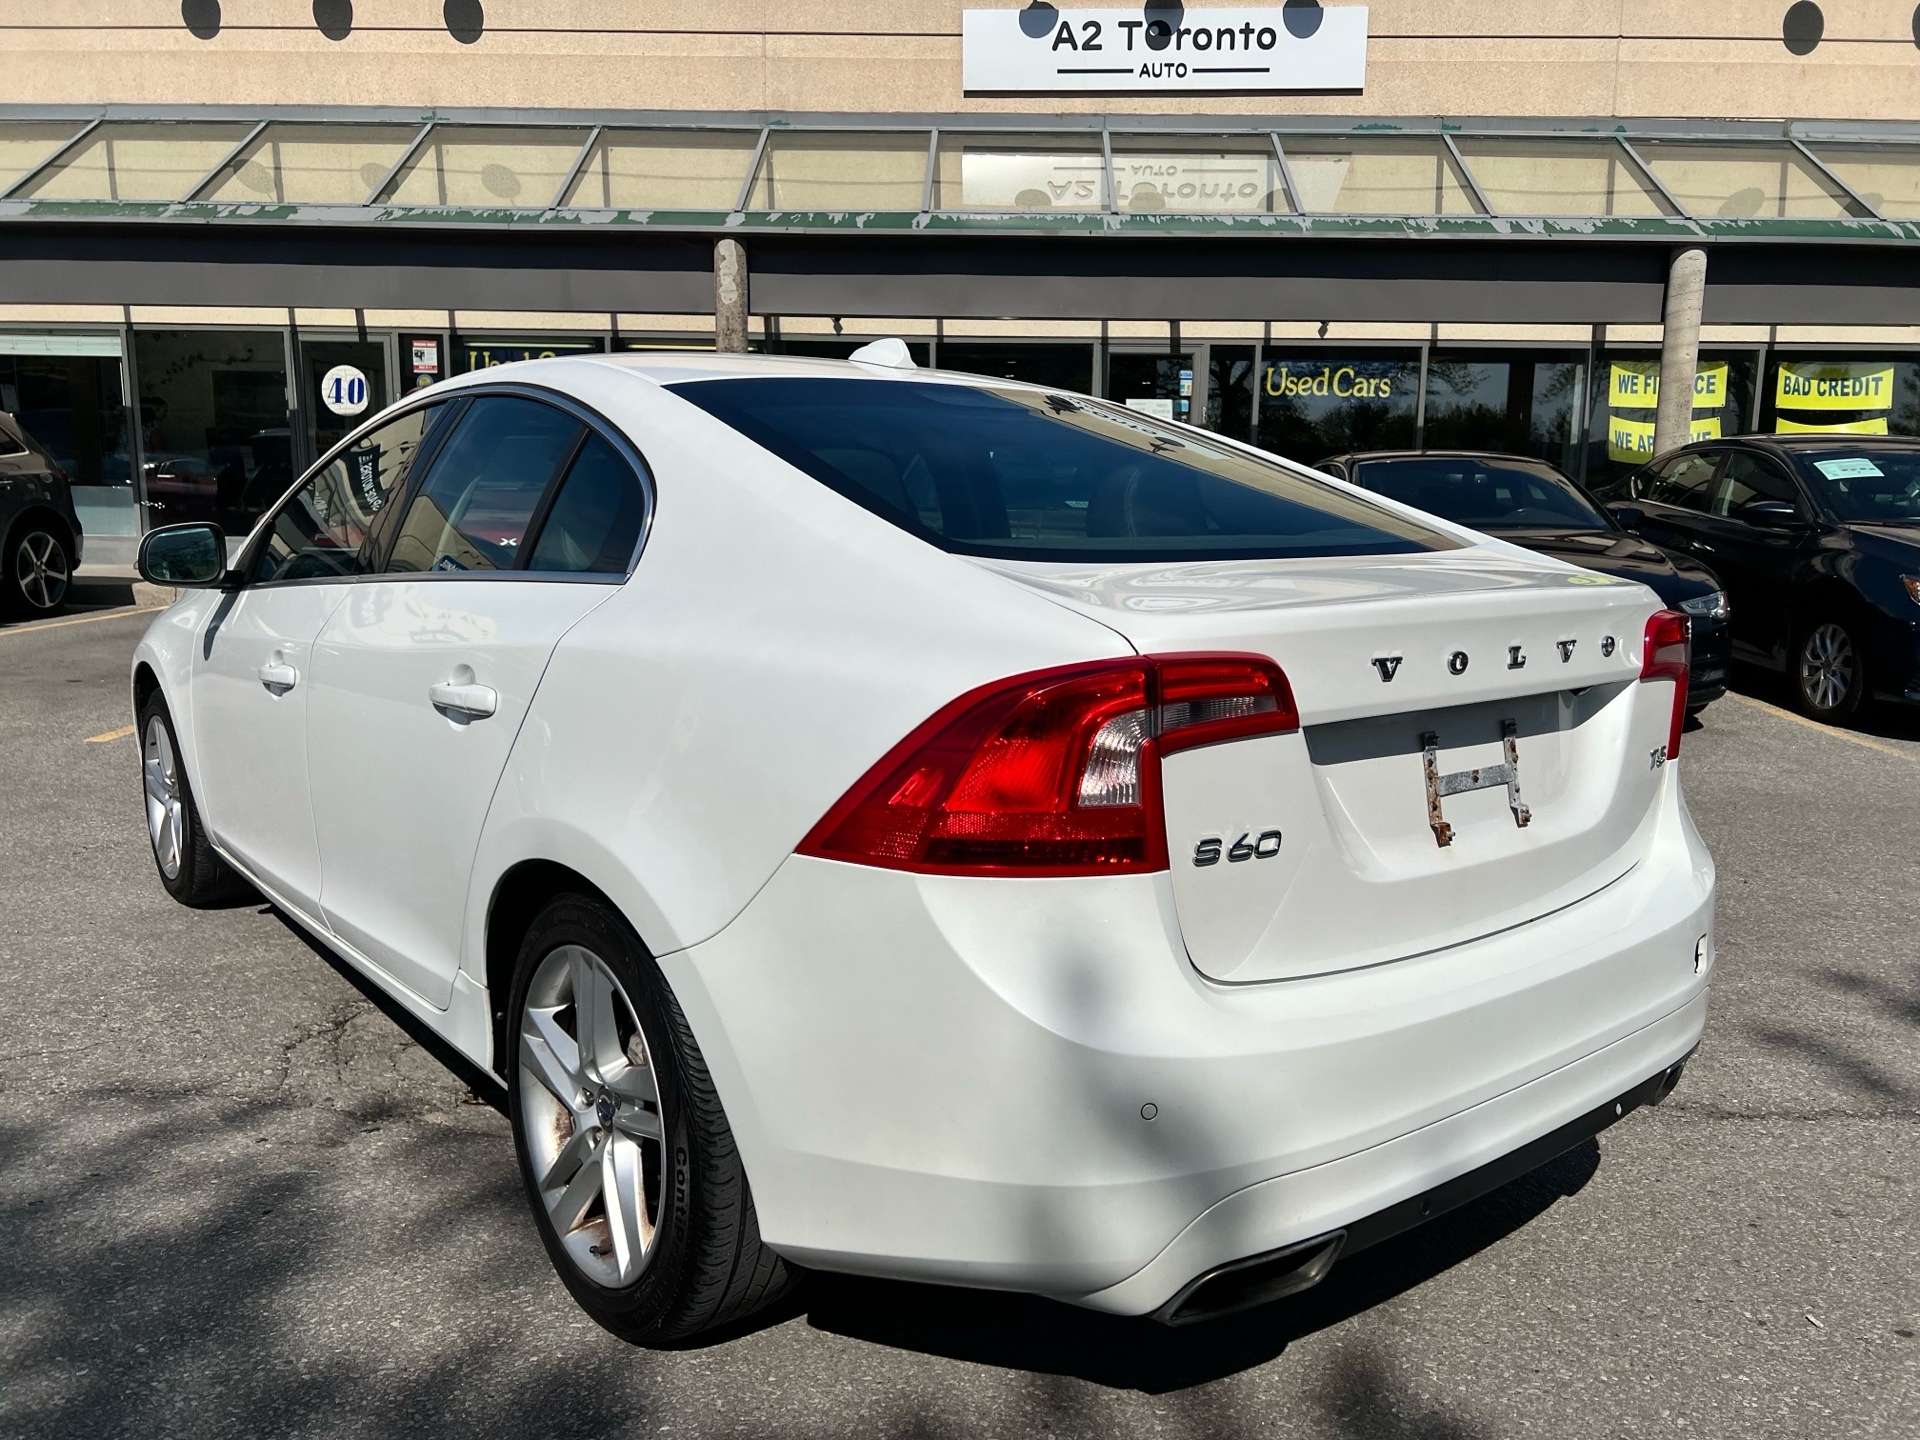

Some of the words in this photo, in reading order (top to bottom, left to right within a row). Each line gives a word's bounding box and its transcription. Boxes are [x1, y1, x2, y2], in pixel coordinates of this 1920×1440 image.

[1051, 20, 1103, 51] A2
[1118, 20, 1277, 51] Toronto
[1139, 62, 1188, 79] AUTO
[328, 377, 365, 405] 40
[1265, 366, 1330, 397] Used
[1332, 366, 1391, 398] Cars
[1618, 374, 1640, 395] WE
[1643, 374, 1717, 395] FICE
[1783, 375, 1812, 396] BAD
[1816, 376, 1883, 397] CREDIT
[1614, 430, 1634, 451] WE
[1371, 634, 1616, 682] VOLVO
[1192, 829, 1282, 867] S60
